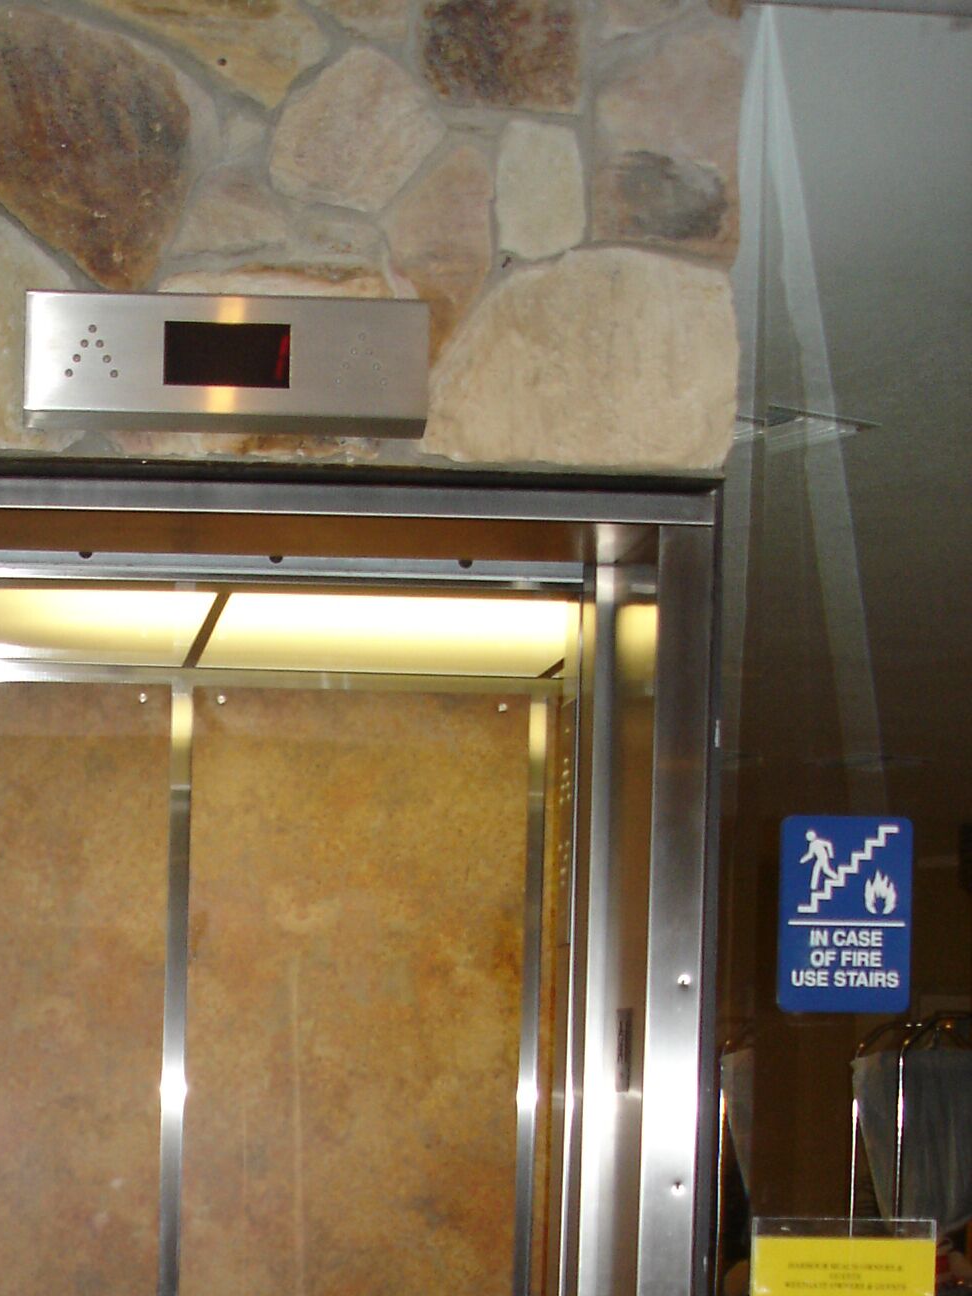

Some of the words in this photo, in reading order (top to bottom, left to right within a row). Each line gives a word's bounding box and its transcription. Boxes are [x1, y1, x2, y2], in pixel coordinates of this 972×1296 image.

[810, 929, 828, 946] IN
[832, 930, 883, 947] CASE
[810, 950, 836, 967] OF
[841, 951, 882, 967] FIRE
[791, 970, 829, 987] USE
[834, 971, 899, 988] STAIRS
